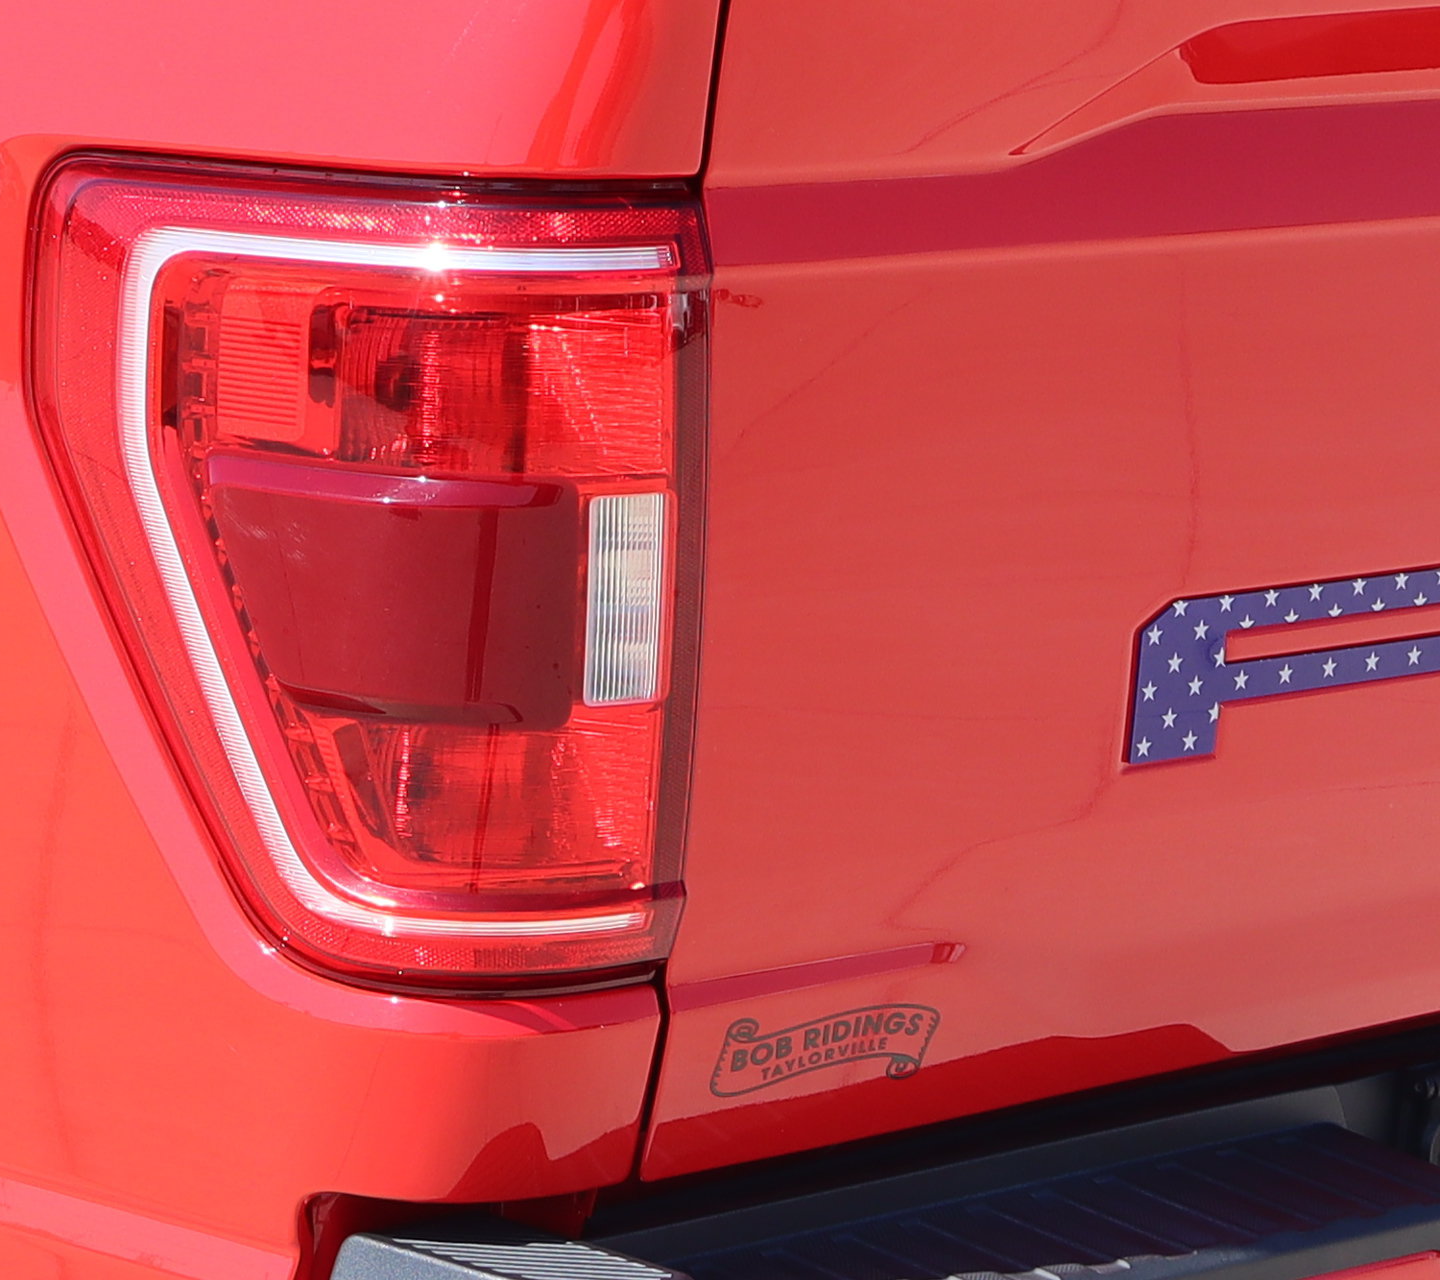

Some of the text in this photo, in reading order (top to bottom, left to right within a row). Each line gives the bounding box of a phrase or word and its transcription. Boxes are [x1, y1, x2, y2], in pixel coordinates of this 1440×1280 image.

[730, 1012, 923, 1072] BOB RIDINGS
[761, 1037, 888, 1081] TAYLORVILLE
